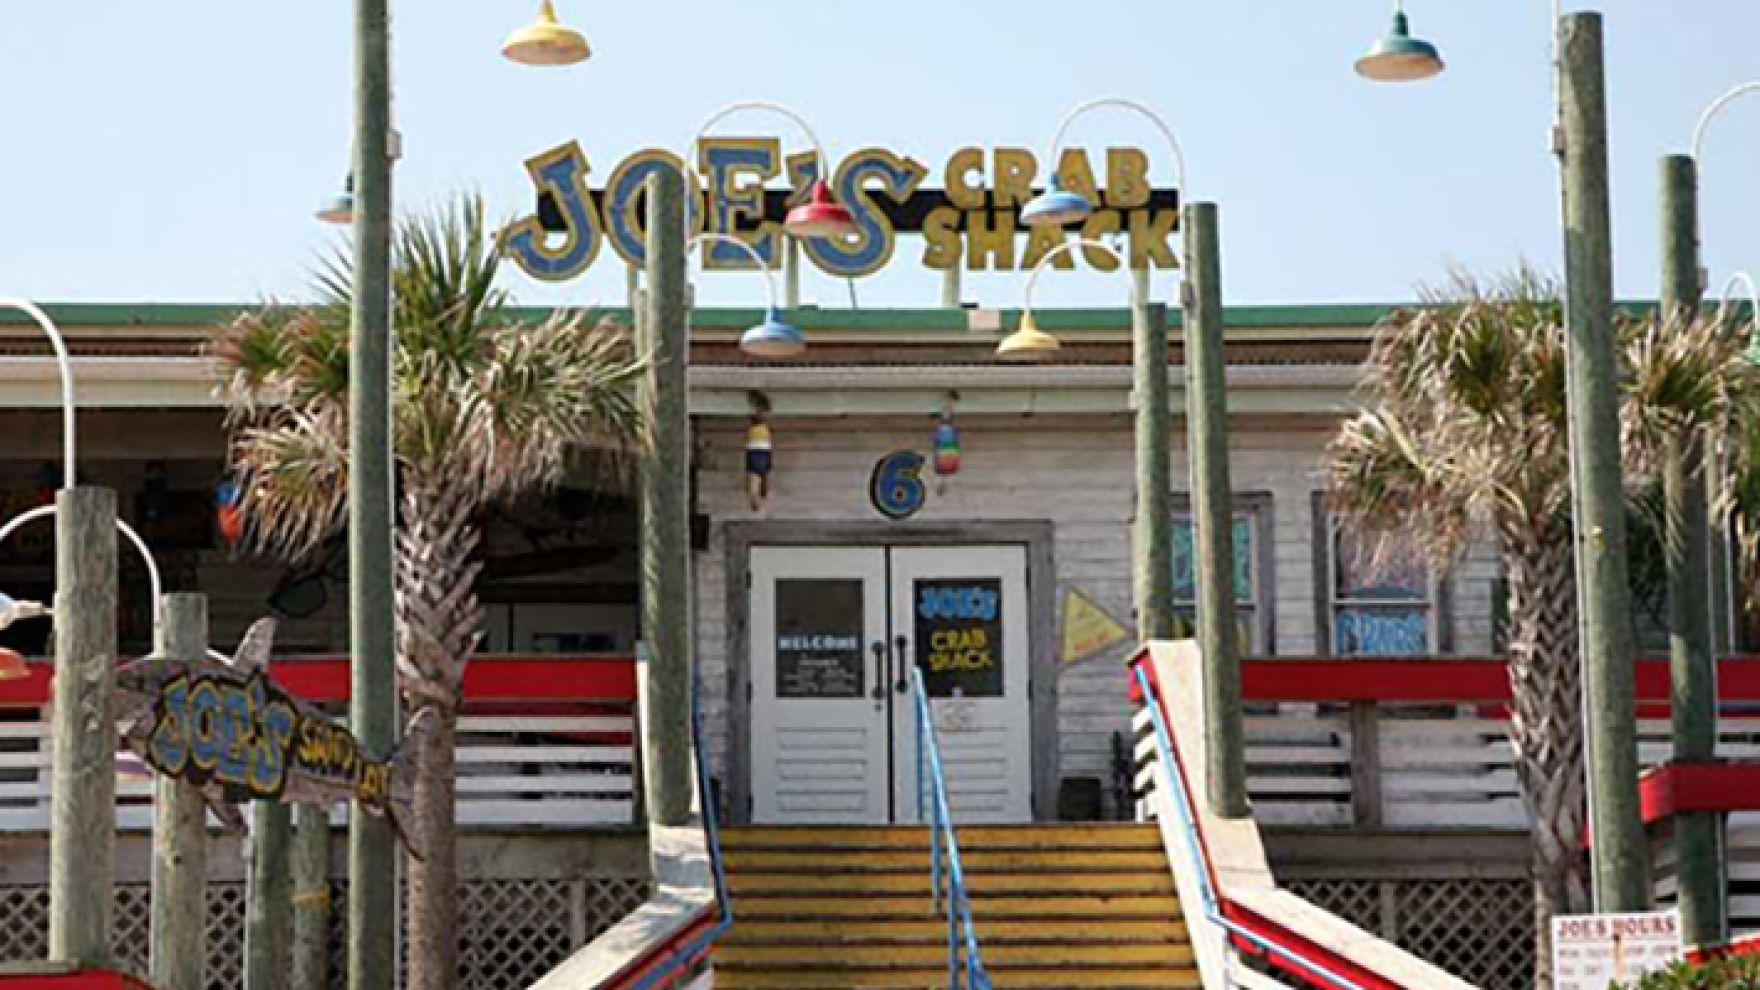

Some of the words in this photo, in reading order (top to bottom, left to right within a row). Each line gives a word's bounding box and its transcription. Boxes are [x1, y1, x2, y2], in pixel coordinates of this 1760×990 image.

[943, 147, 1150, 208] CRAB
[505, 138, 928, 282] JOE'S
[922, 208, 1178, 271] SHACK
[869, 450, 925, 519] 6
[777, 634, 857, 650] WELCOME
[928, 649, 995, 672] SHACK
[930, 629, 987, 650] CRAB
[150, 672, 296, 794] JOE'S
